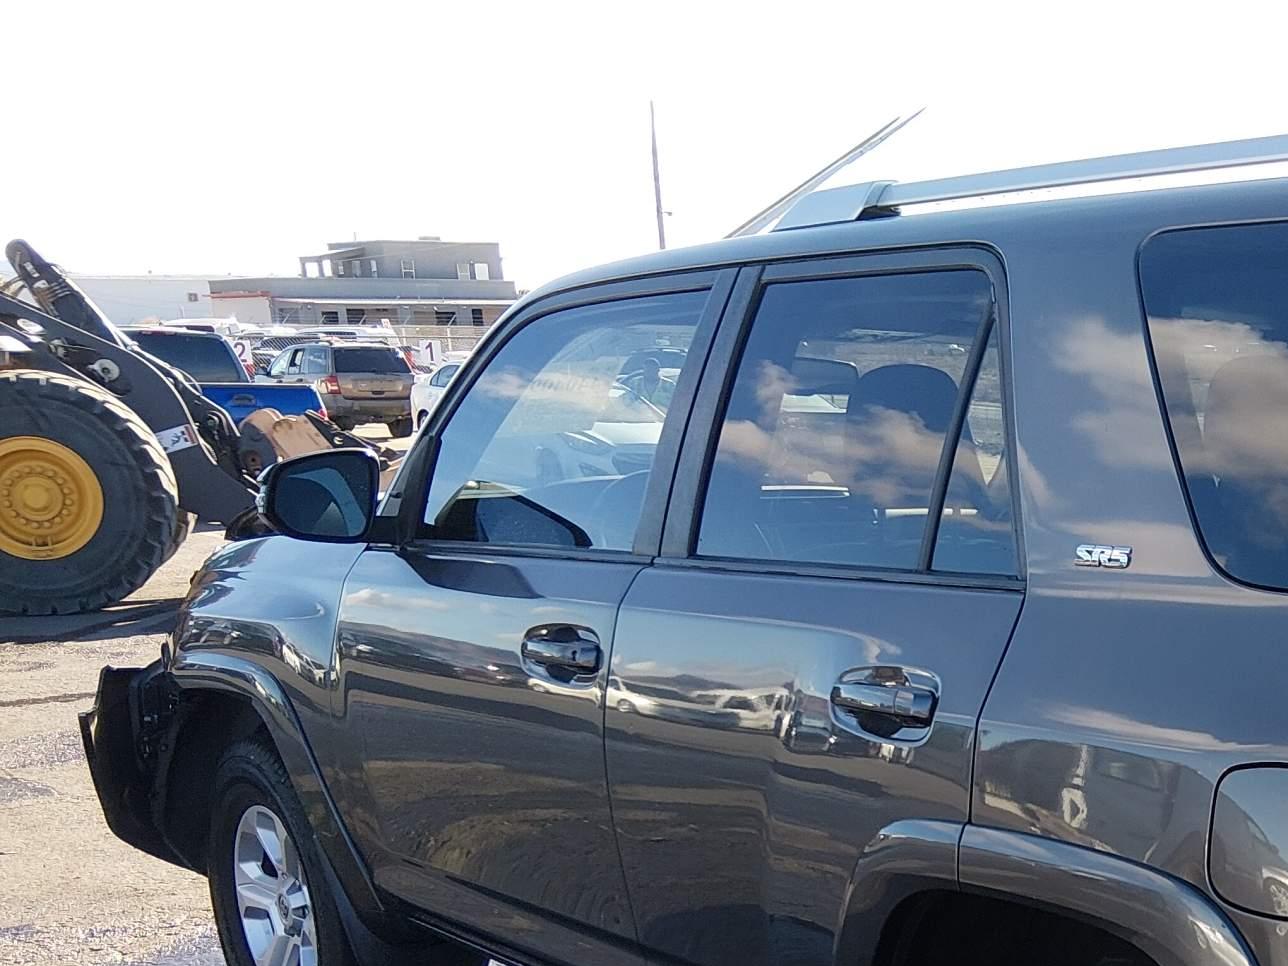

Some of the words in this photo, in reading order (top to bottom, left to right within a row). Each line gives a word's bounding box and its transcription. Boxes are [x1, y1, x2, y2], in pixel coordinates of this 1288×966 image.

[233, 342, 248, 363] 2
[425, 341, 435, 362] 1
[1074, 544, 1132, 569] SR5
